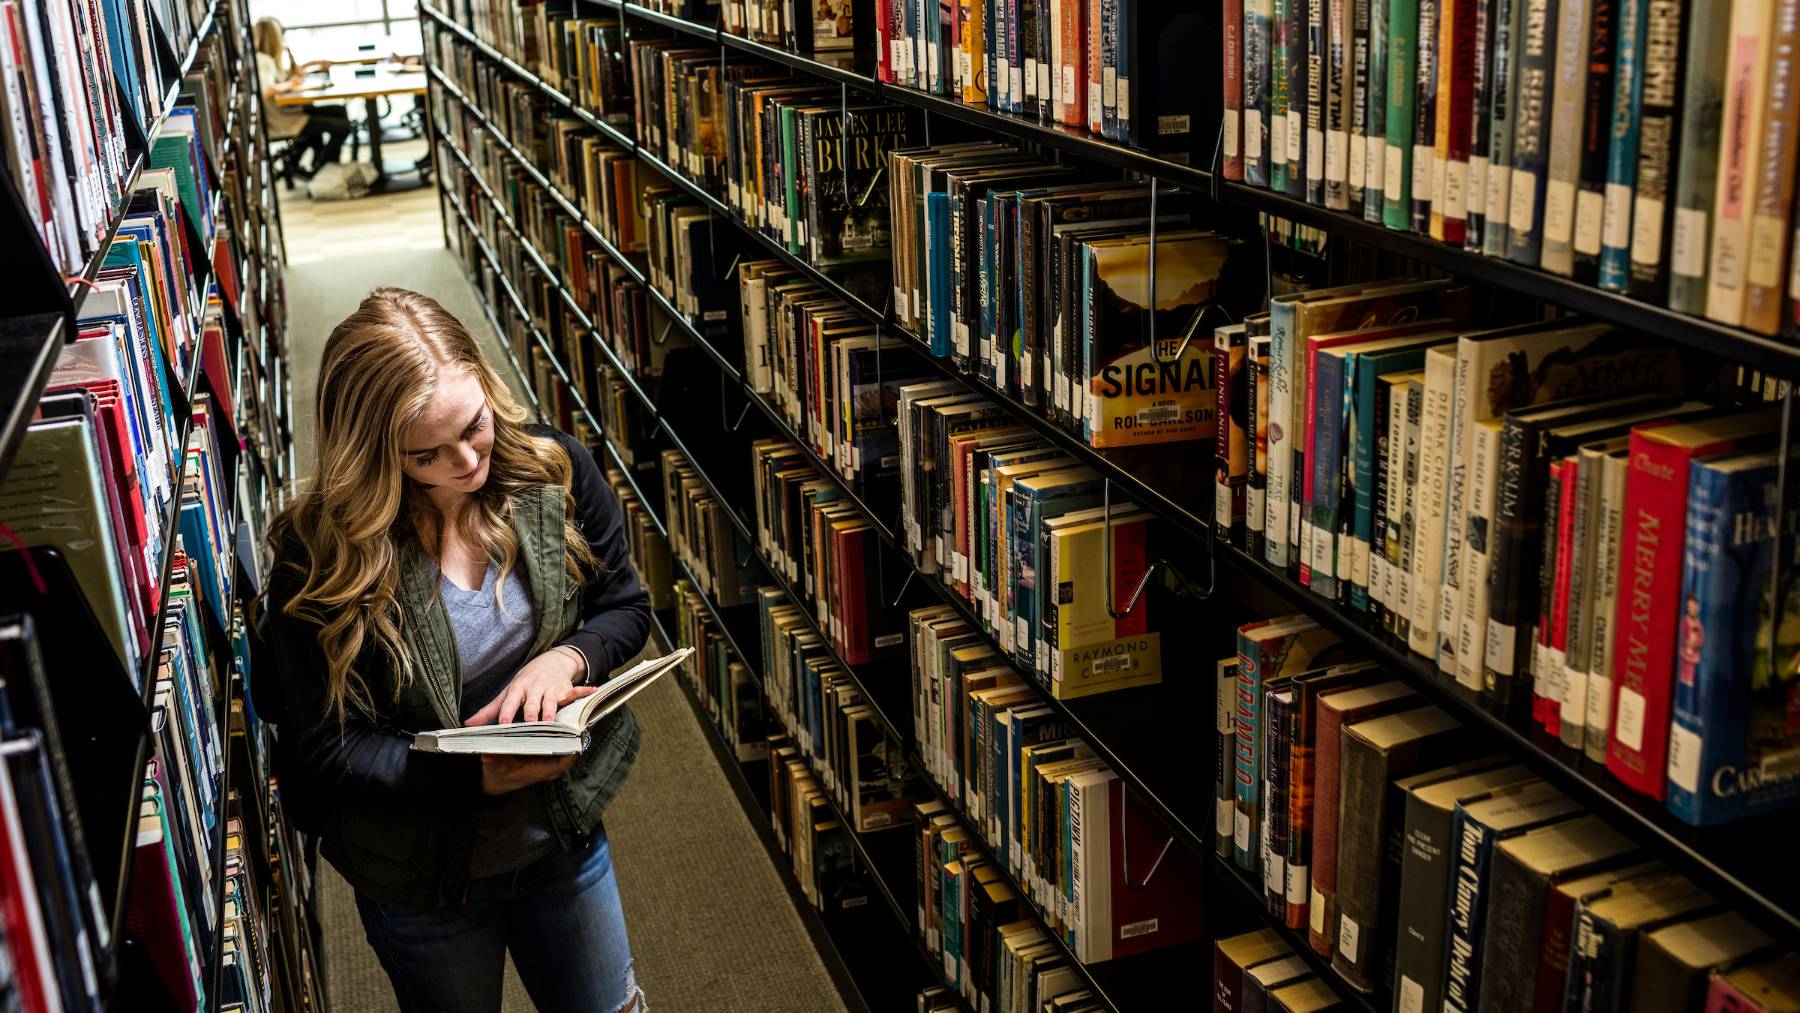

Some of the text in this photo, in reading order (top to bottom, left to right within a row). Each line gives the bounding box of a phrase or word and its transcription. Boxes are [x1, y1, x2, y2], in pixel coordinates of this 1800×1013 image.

[1330, 44, 1342, 97] HEAVY
[875, 111, 908, 134] LEE
[1330, 100, 1341, 132] TIM
[131, 296, 150, 360] CONCLUSIONS
[1156, 341, 1178, 357] HE
[1217, 353, 1226, 457] FALLING ANGELS
[1393, 402, 1402, 421] THE
[1406, 388, 1415, 424] CHOI
[1431, 392, 1450, 519] DEEPAK CHOPRA
[1478, 431, 1487, 451] THE
[1414, 388, 1436, 577] THE RETURN OF MERLIN
[1476, 454, 1486, 485] GREAT
[1274, 474, 1284, 503] TRAC
[1401, 438, 1415, 573] A PERSON OF INTER
[1474, 489, 1483, 511] MAN
[1465, 580, 1477, 621] CHRISTE
[1623, 507, 1662, 692] MERRY ME
[1072, 640, 1148, 665] RAYMOND
[1233, 653, 1257, 786] CARAMELO
[1410, 845, 1433, 864] DANGER
[1416, 839, 1441, 857] PRESENT
[1460, 820, 1485, 866] Tom
[1449, 863, 1481, 936] Clancy
